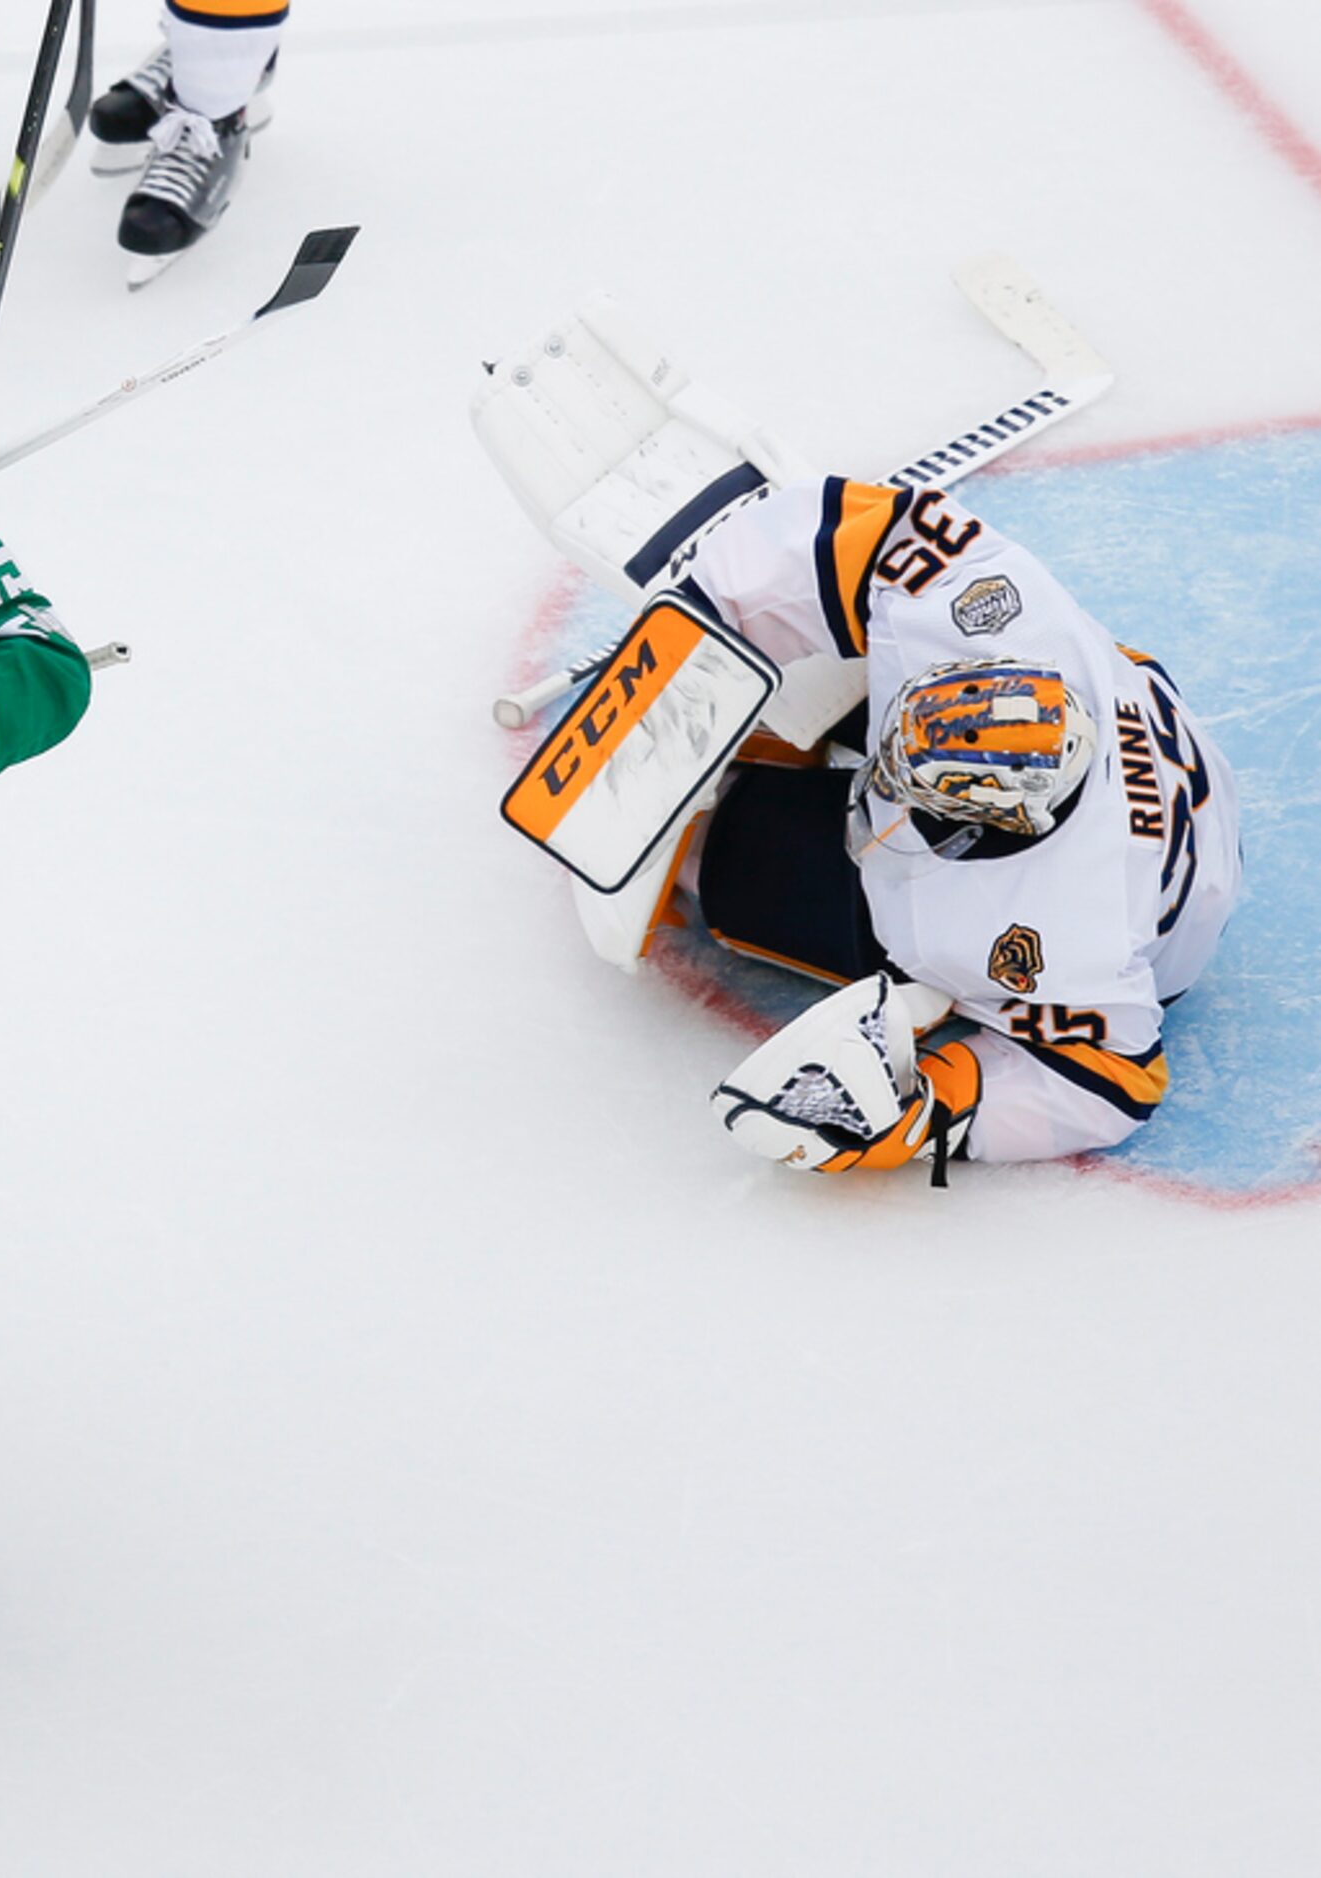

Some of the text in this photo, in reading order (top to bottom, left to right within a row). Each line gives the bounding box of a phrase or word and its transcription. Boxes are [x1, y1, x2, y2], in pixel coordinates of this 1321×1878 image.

[877, 390, 1071, 489] ARRIOR
[876, 489, 982, 597] 35
[538, 637, 658, 797] CCM
[1114, 696, 1165, 840] RINNE
[999, 998, 1108, 1043] 35
